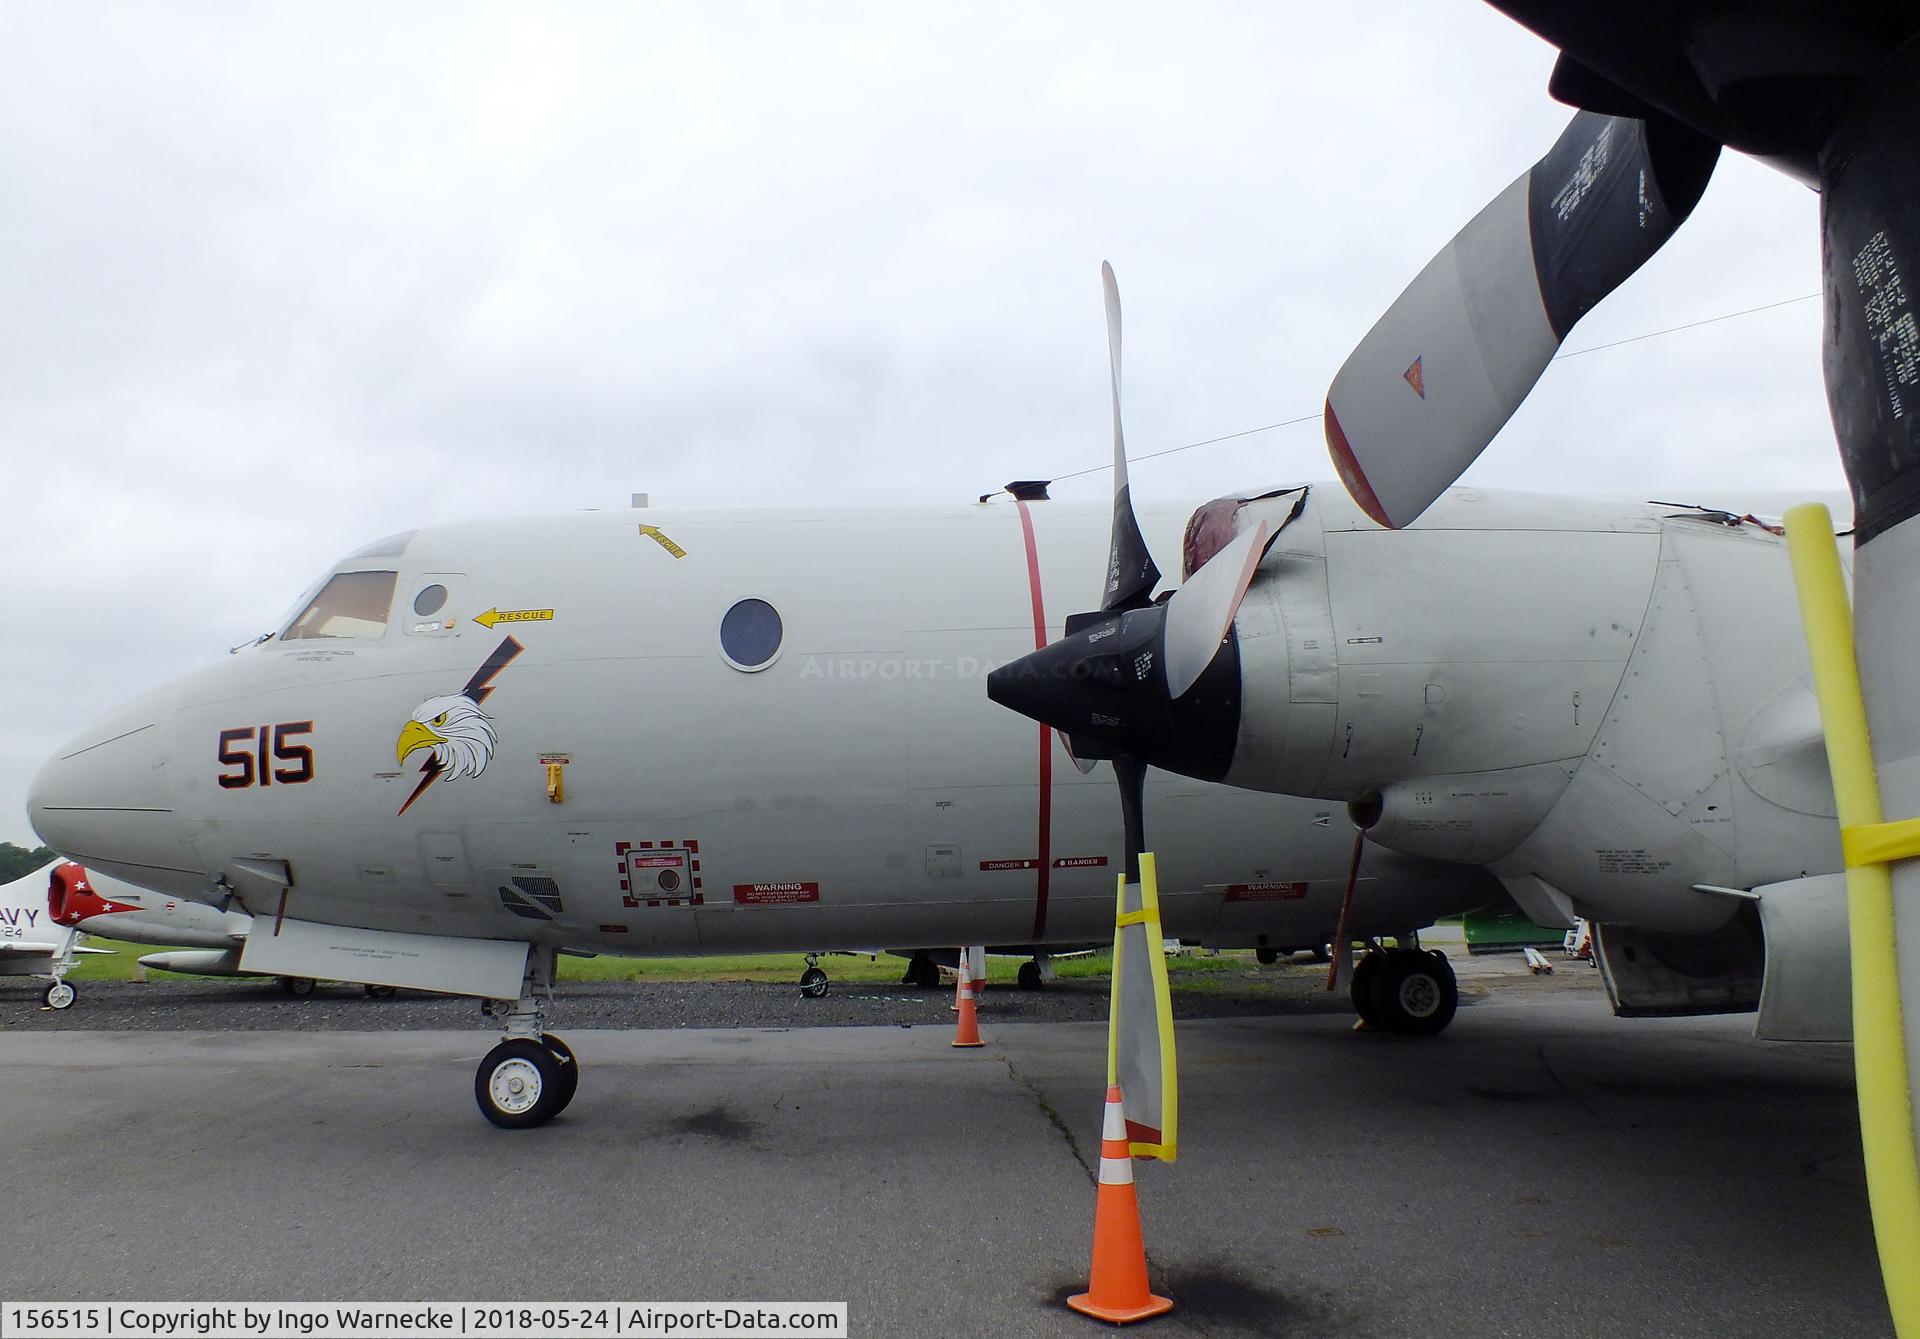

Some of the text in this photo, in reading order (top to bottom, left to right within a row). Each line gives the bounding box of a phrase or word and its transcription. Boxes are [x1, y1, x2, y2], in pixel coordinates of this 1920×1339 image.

[499, 612, 546, 620] RESCUE
[218, 720, 314, 789] 515
[753, 883, 802, 891] WARNING
[1247, 883, 1293, 891] WARNING
